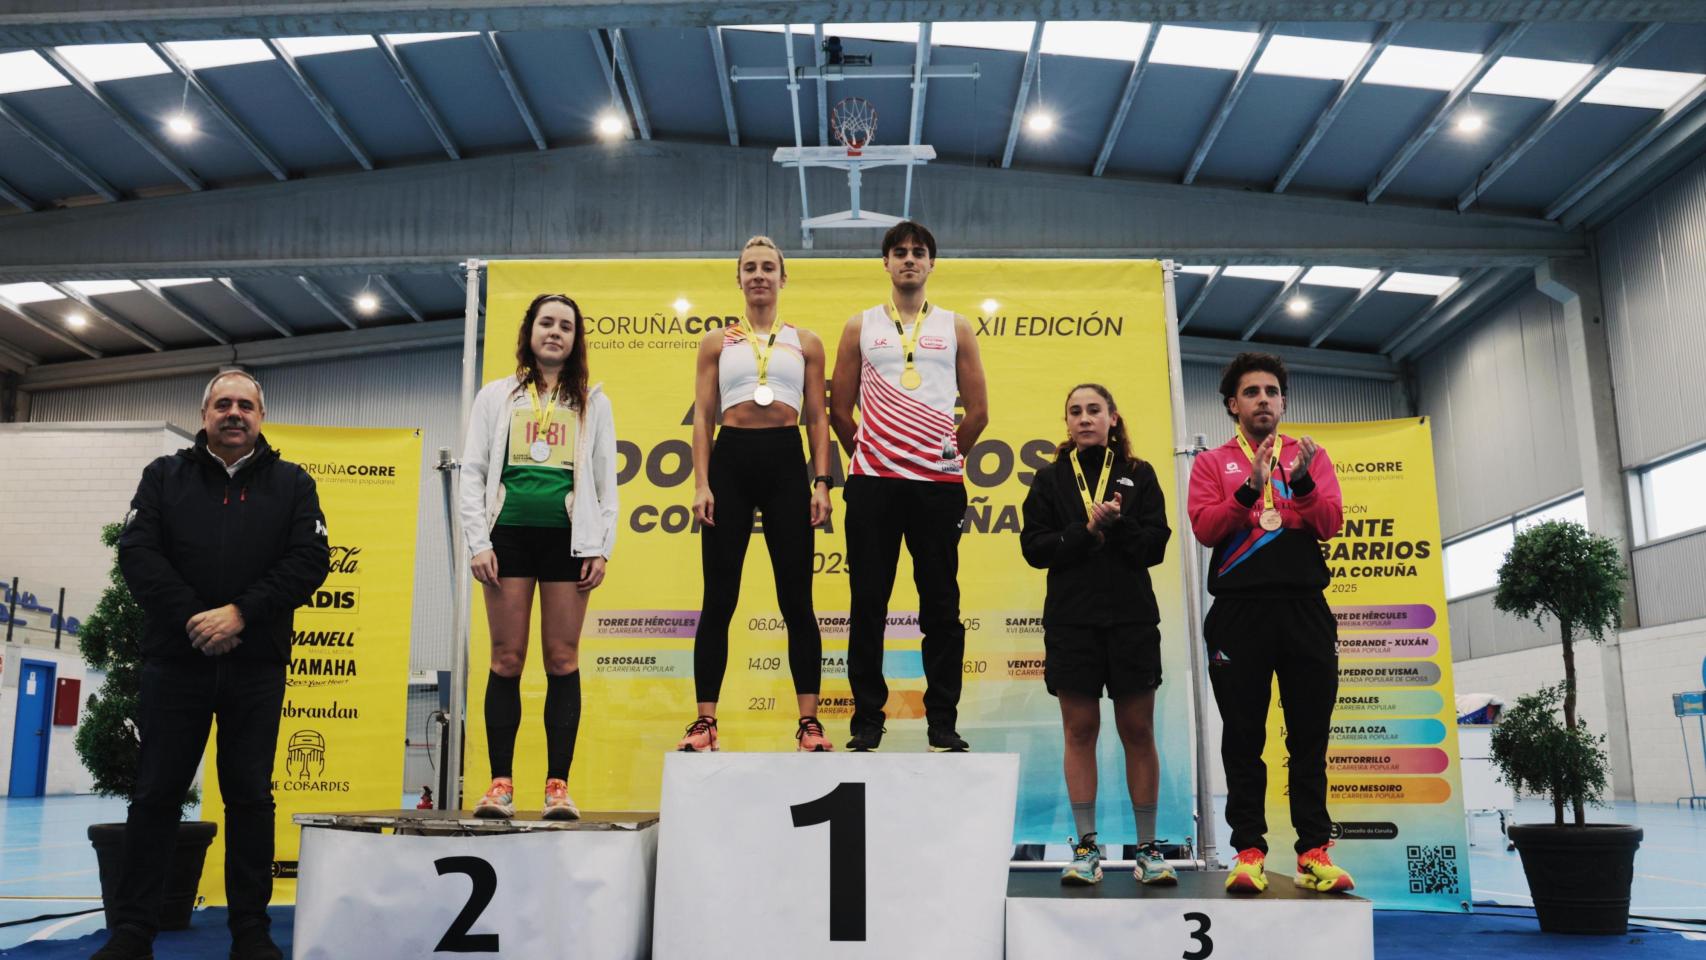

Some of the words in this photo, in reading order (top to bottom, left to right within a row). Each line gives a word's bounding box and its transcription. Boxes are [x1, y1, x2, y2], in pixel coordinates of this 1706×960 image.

[976, 316, 1006, 336] XII
[1015, 311, 1123, 336] EDICIÓN
[628, 338, 643, 350] de
[1350, 563, 1418, 577] CORUÑA
[1332, 584, 1357, 593] 2025
[1350, 612, 1361, 620] DE
[1362, 611, 1408, 620] HÉRCULES
[598, 618, 629, 626] TORRE
[631, 618, 643, 626] DE
[644, 616, 696, 627] HÉRCULES
[748, 618, 785, 631] 06.04
[1005, 617, 1027, 626] SAN
[1394, 637, 1429, 646] XUXÁN
[596, 656, 611, 665] OS
[612, 656, 657, 665] ROSALES
[748, 657, 781, 670] 14.09
[835, 657, 844, 665] A
[290, 658, 356, 676] YAMAHA
[1344, 668, 1374, 676] PEDRO
[1375, 668, 1387, 676] DE
[1388, 667, 1419, 676] VISMA
[748, 697, 775, 710] 23.11
[1339, 696, 1380, 704] ROSALES
[1329, 756, 1391, 764] VENTORRILLO
[283, 781, 351, 792] COBARDES
[1330, 784, 1358, 792] NOVO
[1360, 784, 1403, 792] MESOIRO
[790, 782, 866, 941] 1
[433, 855, 499, 952] 2
[1182, 912, 1213, 960] 3
